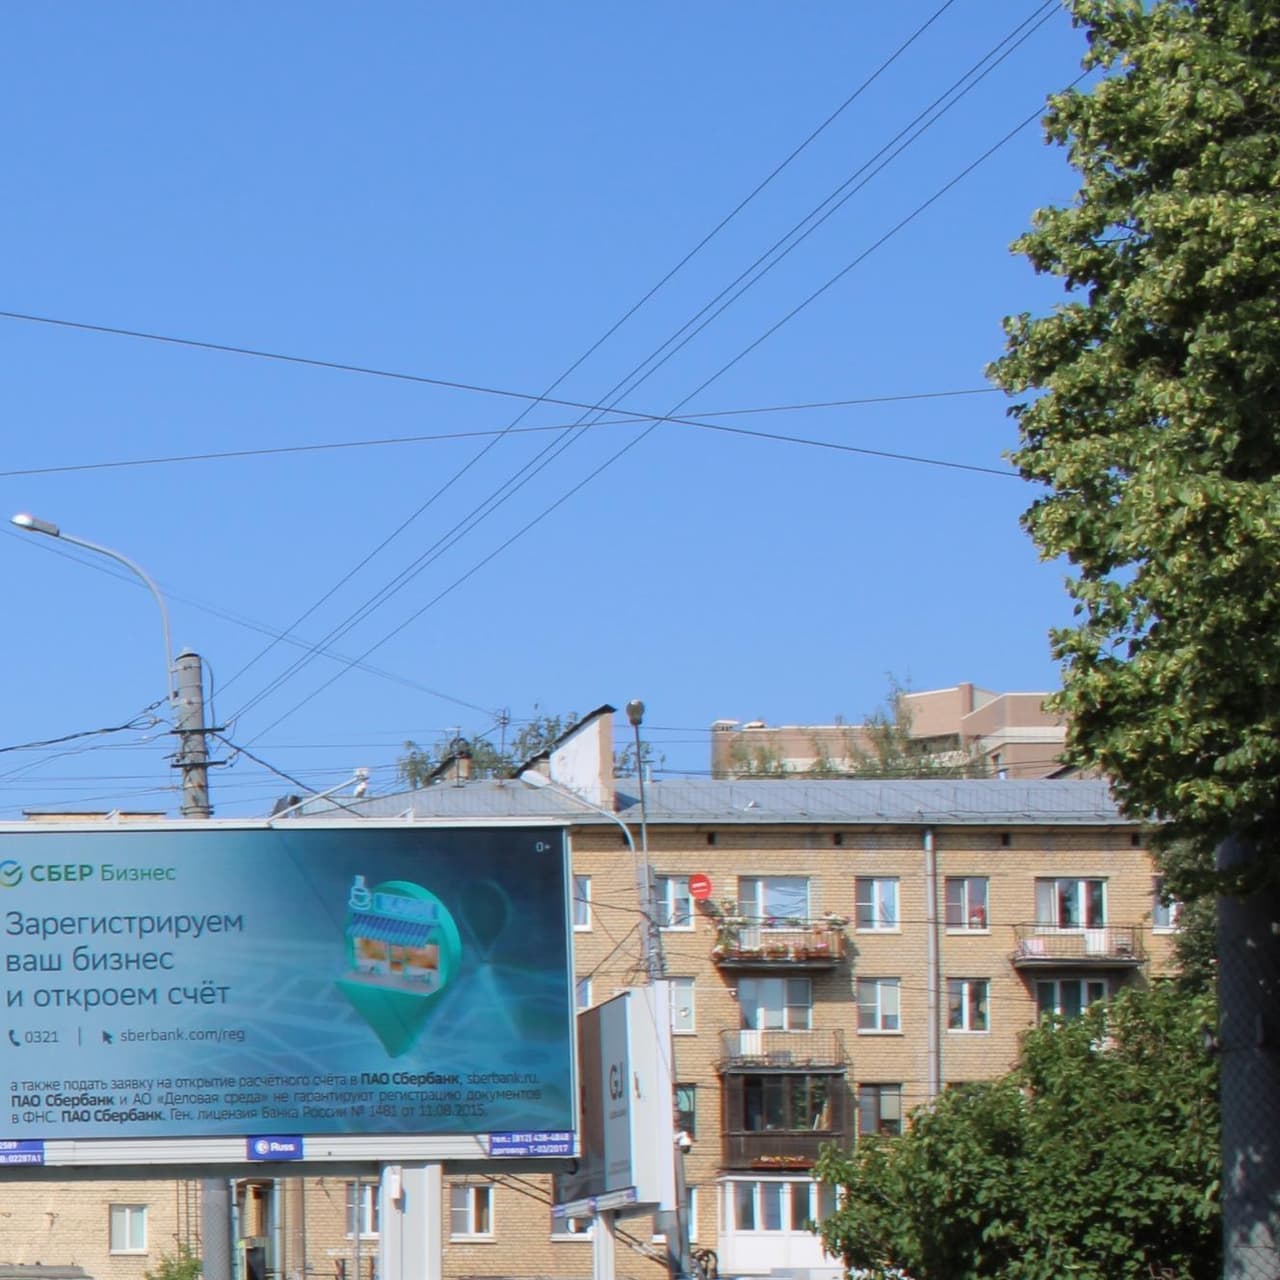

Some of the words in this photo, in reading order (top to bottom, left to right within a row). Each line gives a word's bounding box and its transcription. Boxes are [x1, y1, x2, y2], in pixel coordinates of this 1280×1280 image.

[30, 863, 93, 882] СБЕР
[100, 863, 176, 882] Бизнес
[5, 910, 244, 940] Зарегистрируем
[6, 952, 62, 972] ваш
[72, 945, 175, 972] бизнес
[6, 988, 23, 1007] и
[33, 984, 158, 1013] откроем
[167, 980, 231, 1006] счёт
[24, 1029, 59, 1044] 0321
[120, 1027, 245, 1043] sberbank.com/reg
[10, 1082, 18, 1092] а
[21, 1079, 61, 1092] также
[63, 1078, 108, 1093] подать
[111, 1077, 154, 1091] заявку
[156, 1078, 172, 1089] на
[175, 1076, 236, 1091] открытие
[239, 1073, 310, 1088] расчётного
[313, 1073, 346, 1087] счёта
[350, 1076, 358, 1086] в
[360, 1072, 390, 1086] ПАО
[11, 1095, 41, 1108] ПАО
[45, 1093, 115, 1109] Сбербанк
[119, 1096, 128, 1106] и
[133, 1093, 152, 1106] АО
[157, 1091, 219, 1106] «Деловая
[273, 1091, 289, 1102] не
[294, 1088, 374, 1104] гарантируют
[378, 1087, 463, 1103] регистрацию
[466, 1086, 543, 1102] документов
[11, 1114, 19, 1124] в
[61, 1109, 91, 1123] ПАО
[197, 1108, 257, 1121] лицензия
[261, 1105, 299, 1119] Банка
[302, 1104, 348, 1118] России
[401, 1105, 416, 1117] от
[270, 1142, 296, 1152] Russ
